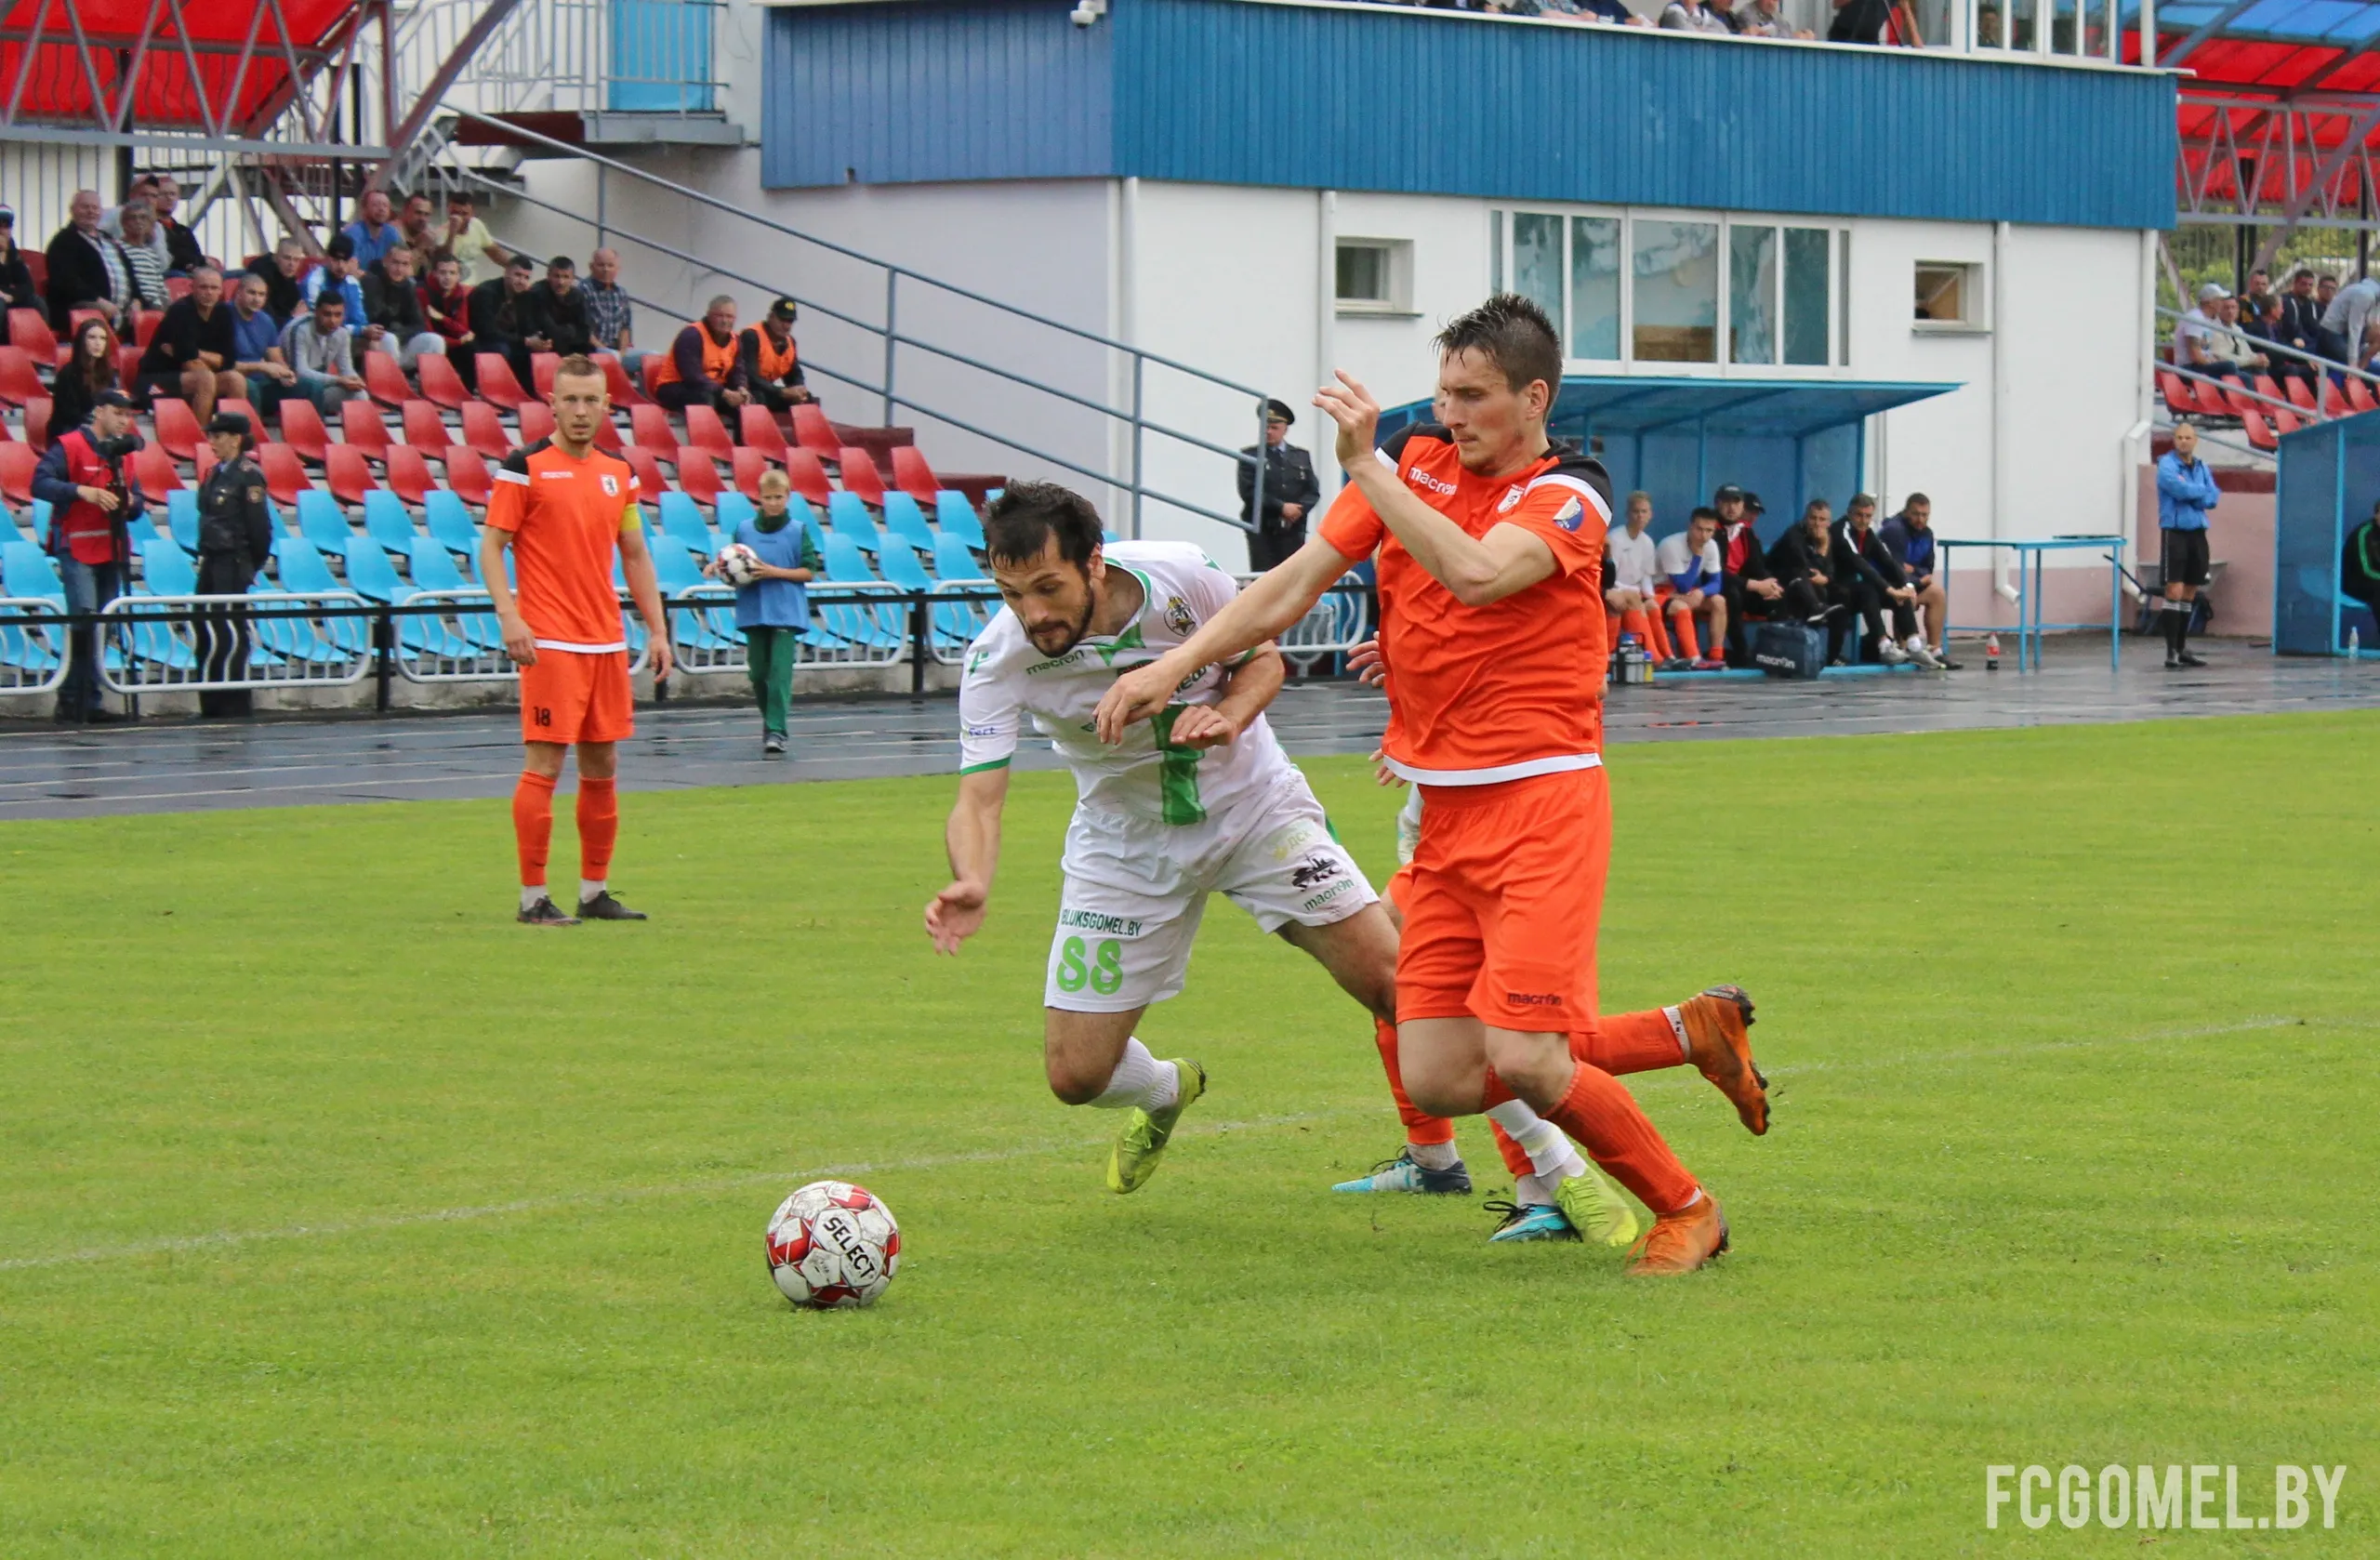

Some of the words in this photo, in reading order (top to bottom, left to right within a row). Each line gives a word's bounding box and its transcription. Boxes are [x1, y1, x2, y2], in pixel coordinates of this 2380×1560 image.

[1408, 467, 1458, 496] macron
[1026, 649, 1085, 676] macron
[534, 707, 550, 726] 18
[1303, 879, 1355, 912] macron
[823, 1217, 876, 1279] SELECT
